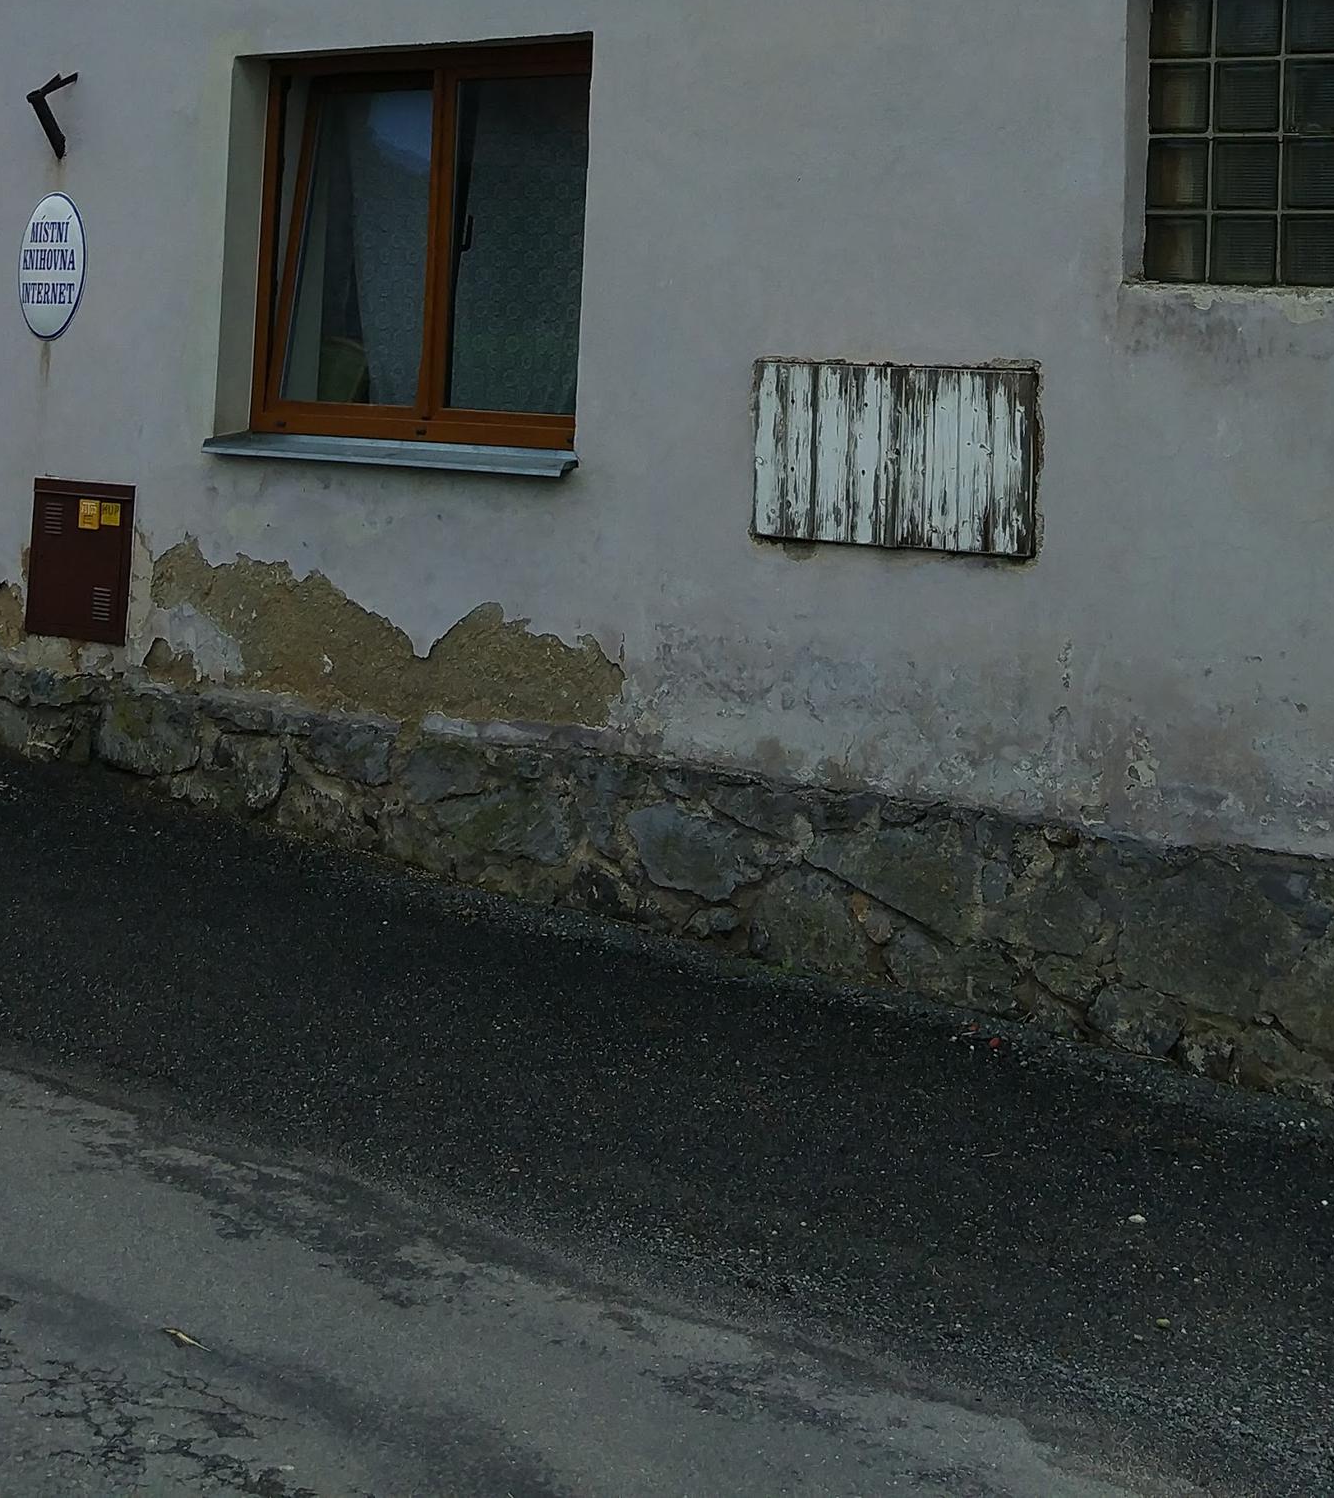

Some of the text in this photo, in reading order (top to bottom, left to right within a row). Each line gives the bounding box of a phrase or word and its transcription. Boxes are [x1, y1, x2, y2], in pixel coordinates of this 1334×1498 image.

[30, 215, 72, 243] MÍSTNÍ
[22, 249, 76, 271] KNIHOVNA
[22, 282, 75, 305] INTERNET
